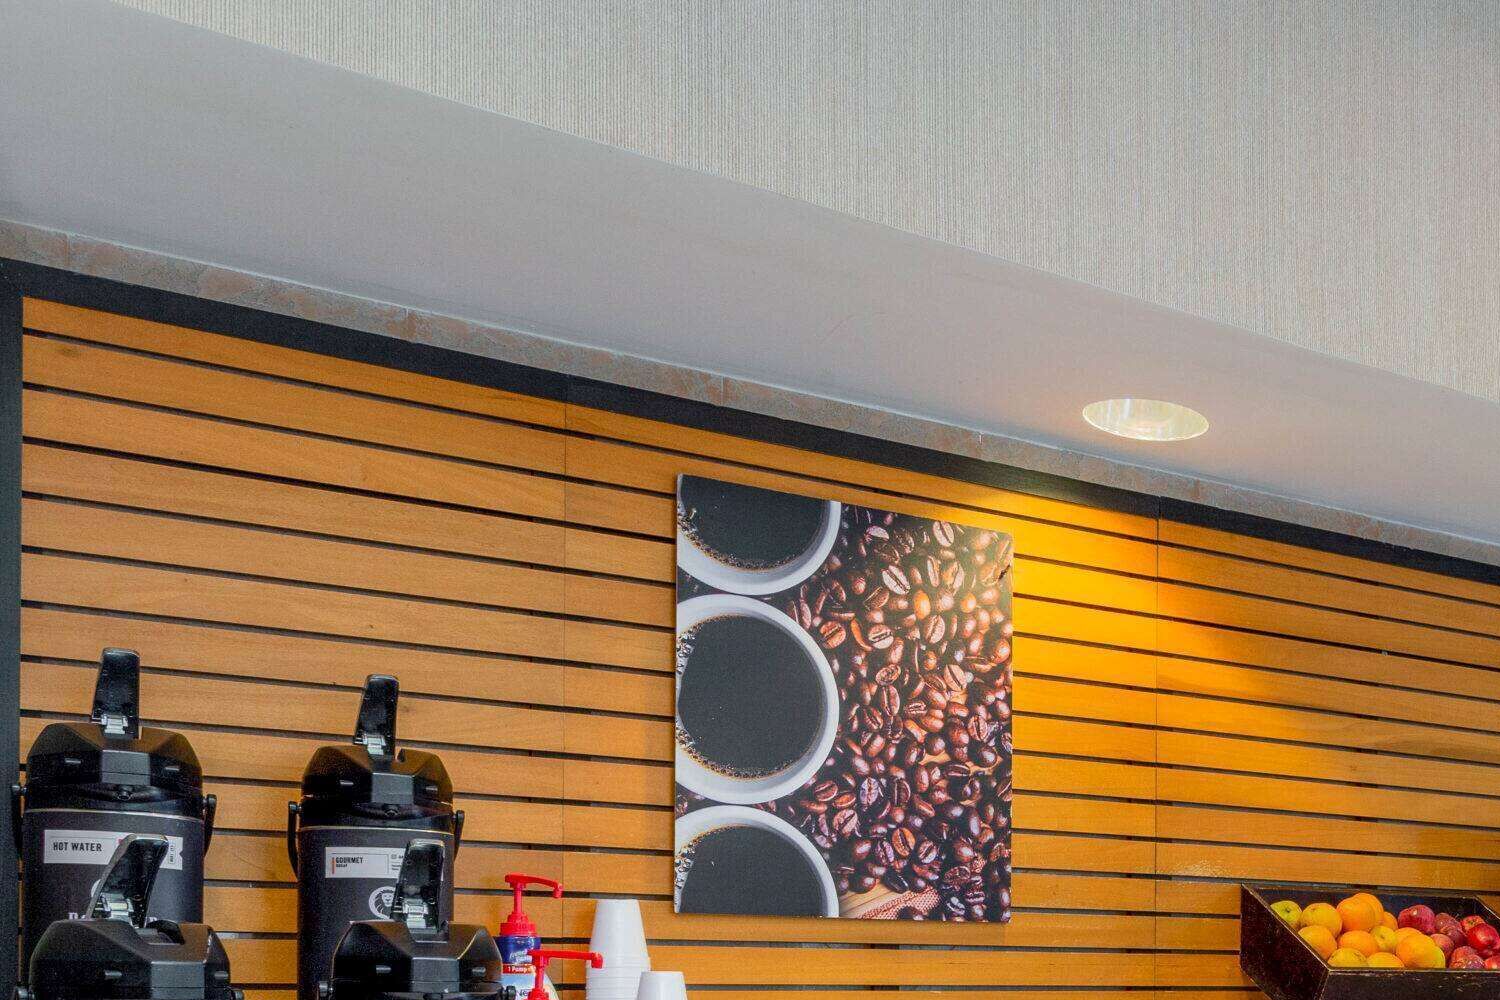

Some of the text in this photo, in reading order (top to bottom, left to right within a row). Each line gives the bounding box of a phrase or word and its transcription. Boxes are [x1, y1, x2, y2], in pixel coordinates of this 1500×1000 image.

[53, 841, 102, 852] HOT WATER
[335, 856, 364, 864] GOURMET
